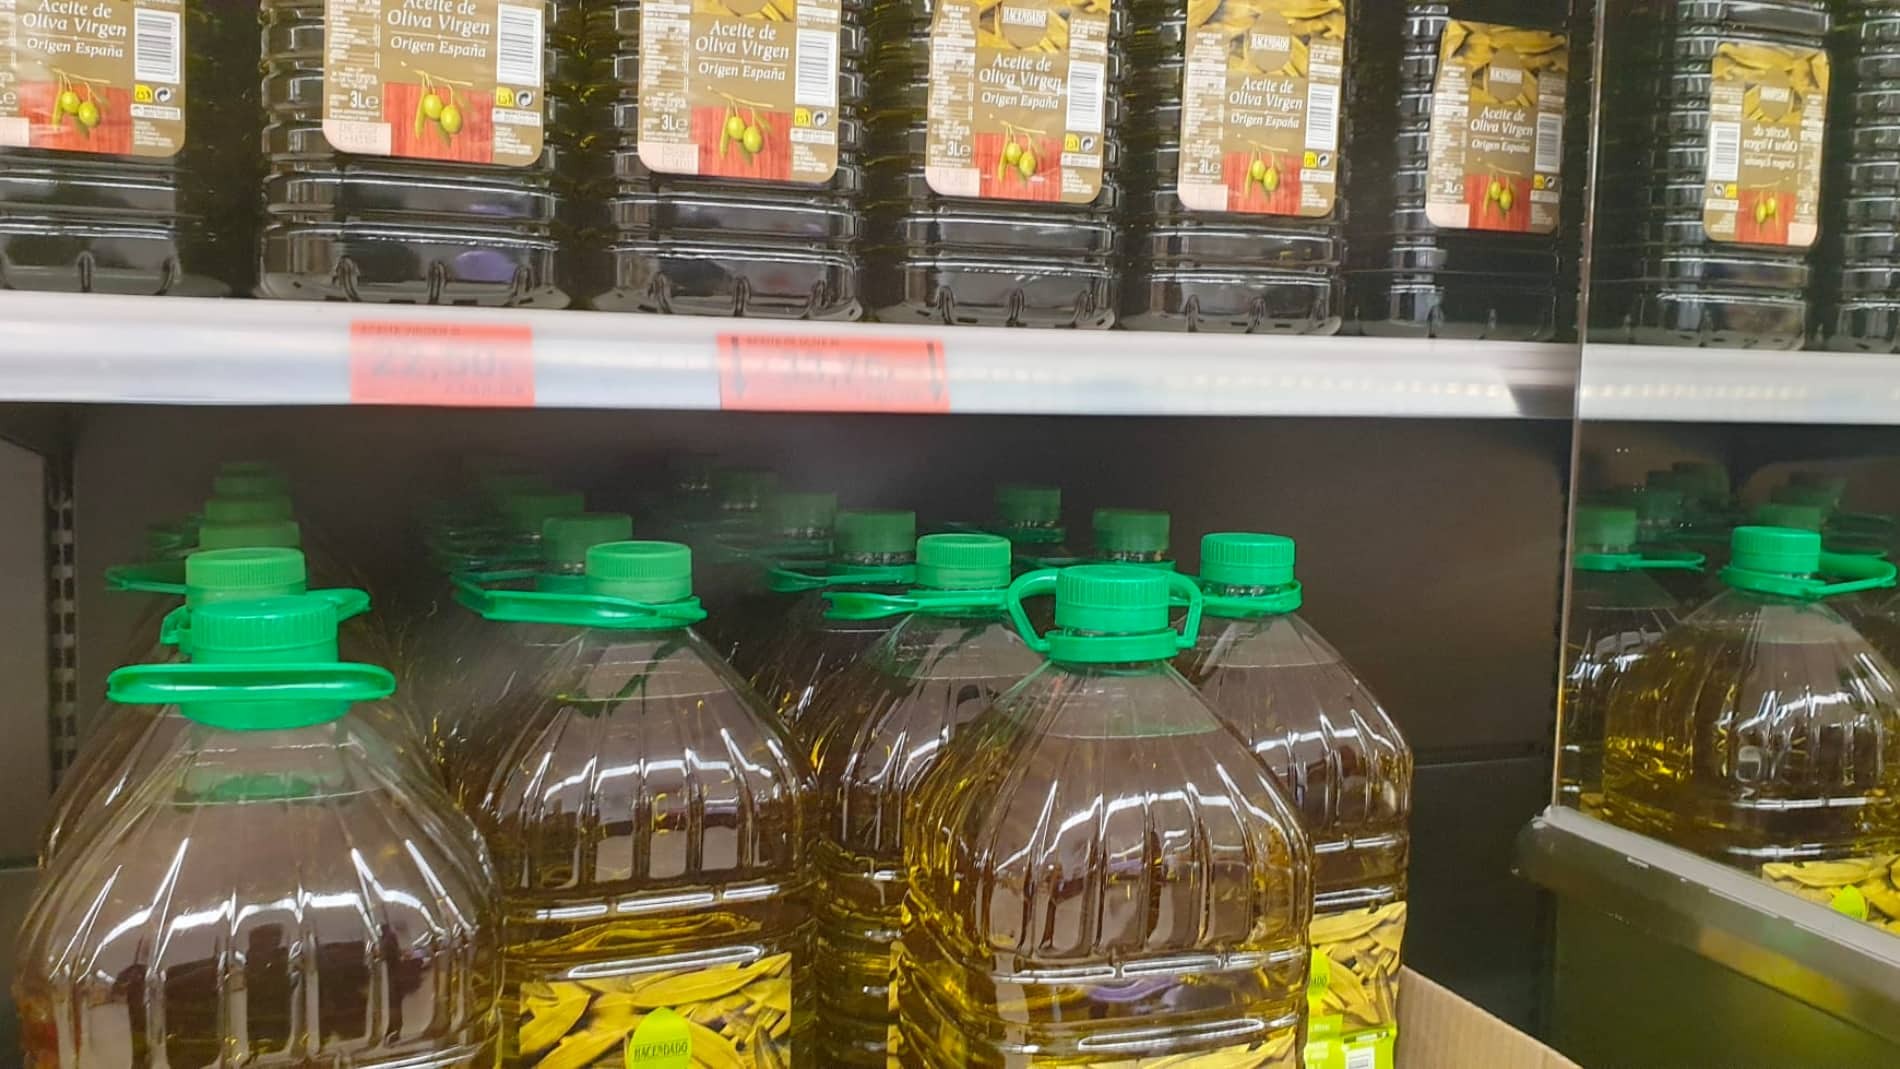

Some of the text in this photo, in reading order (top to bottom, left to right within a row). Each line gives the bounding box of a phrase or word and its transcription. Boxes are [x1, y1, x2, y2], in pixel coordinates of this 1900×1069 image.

[38, 0, 113, 18] Aceite de
[403, 0, 476, 16] Aceite de
[23, 13, 127, 38] Oliva Virgen
[387, 9, 490, 36] Oliva Virgen
[710, 20, 777, 40] Aceite de
[27, 38, 124, 58] Origen España
[391, 36, 487, 59] Origen España
[695, 36, 789, 61] Oliva Virgen
[698, 62, 786, 81] Origen España
[993, 54, 1052, 72] Aceite de
[979, 69, 1062, 92] Oliva Virgen
[1241, 77, 1294, 94] Aceite de
[982, 91, 1059, 110] Origen España
[1229, 90, 1303, 111] Oliva Virgen
[1231, 113, 1300, 129] Origen España
[1481, 106, 1526, 121] Aceite de
[1470, 119, 1534, 138] Oliva Virgen
[1471, 139, 1500, 153] Origen
[633, 1042, 688, 1063] HACENDADO
